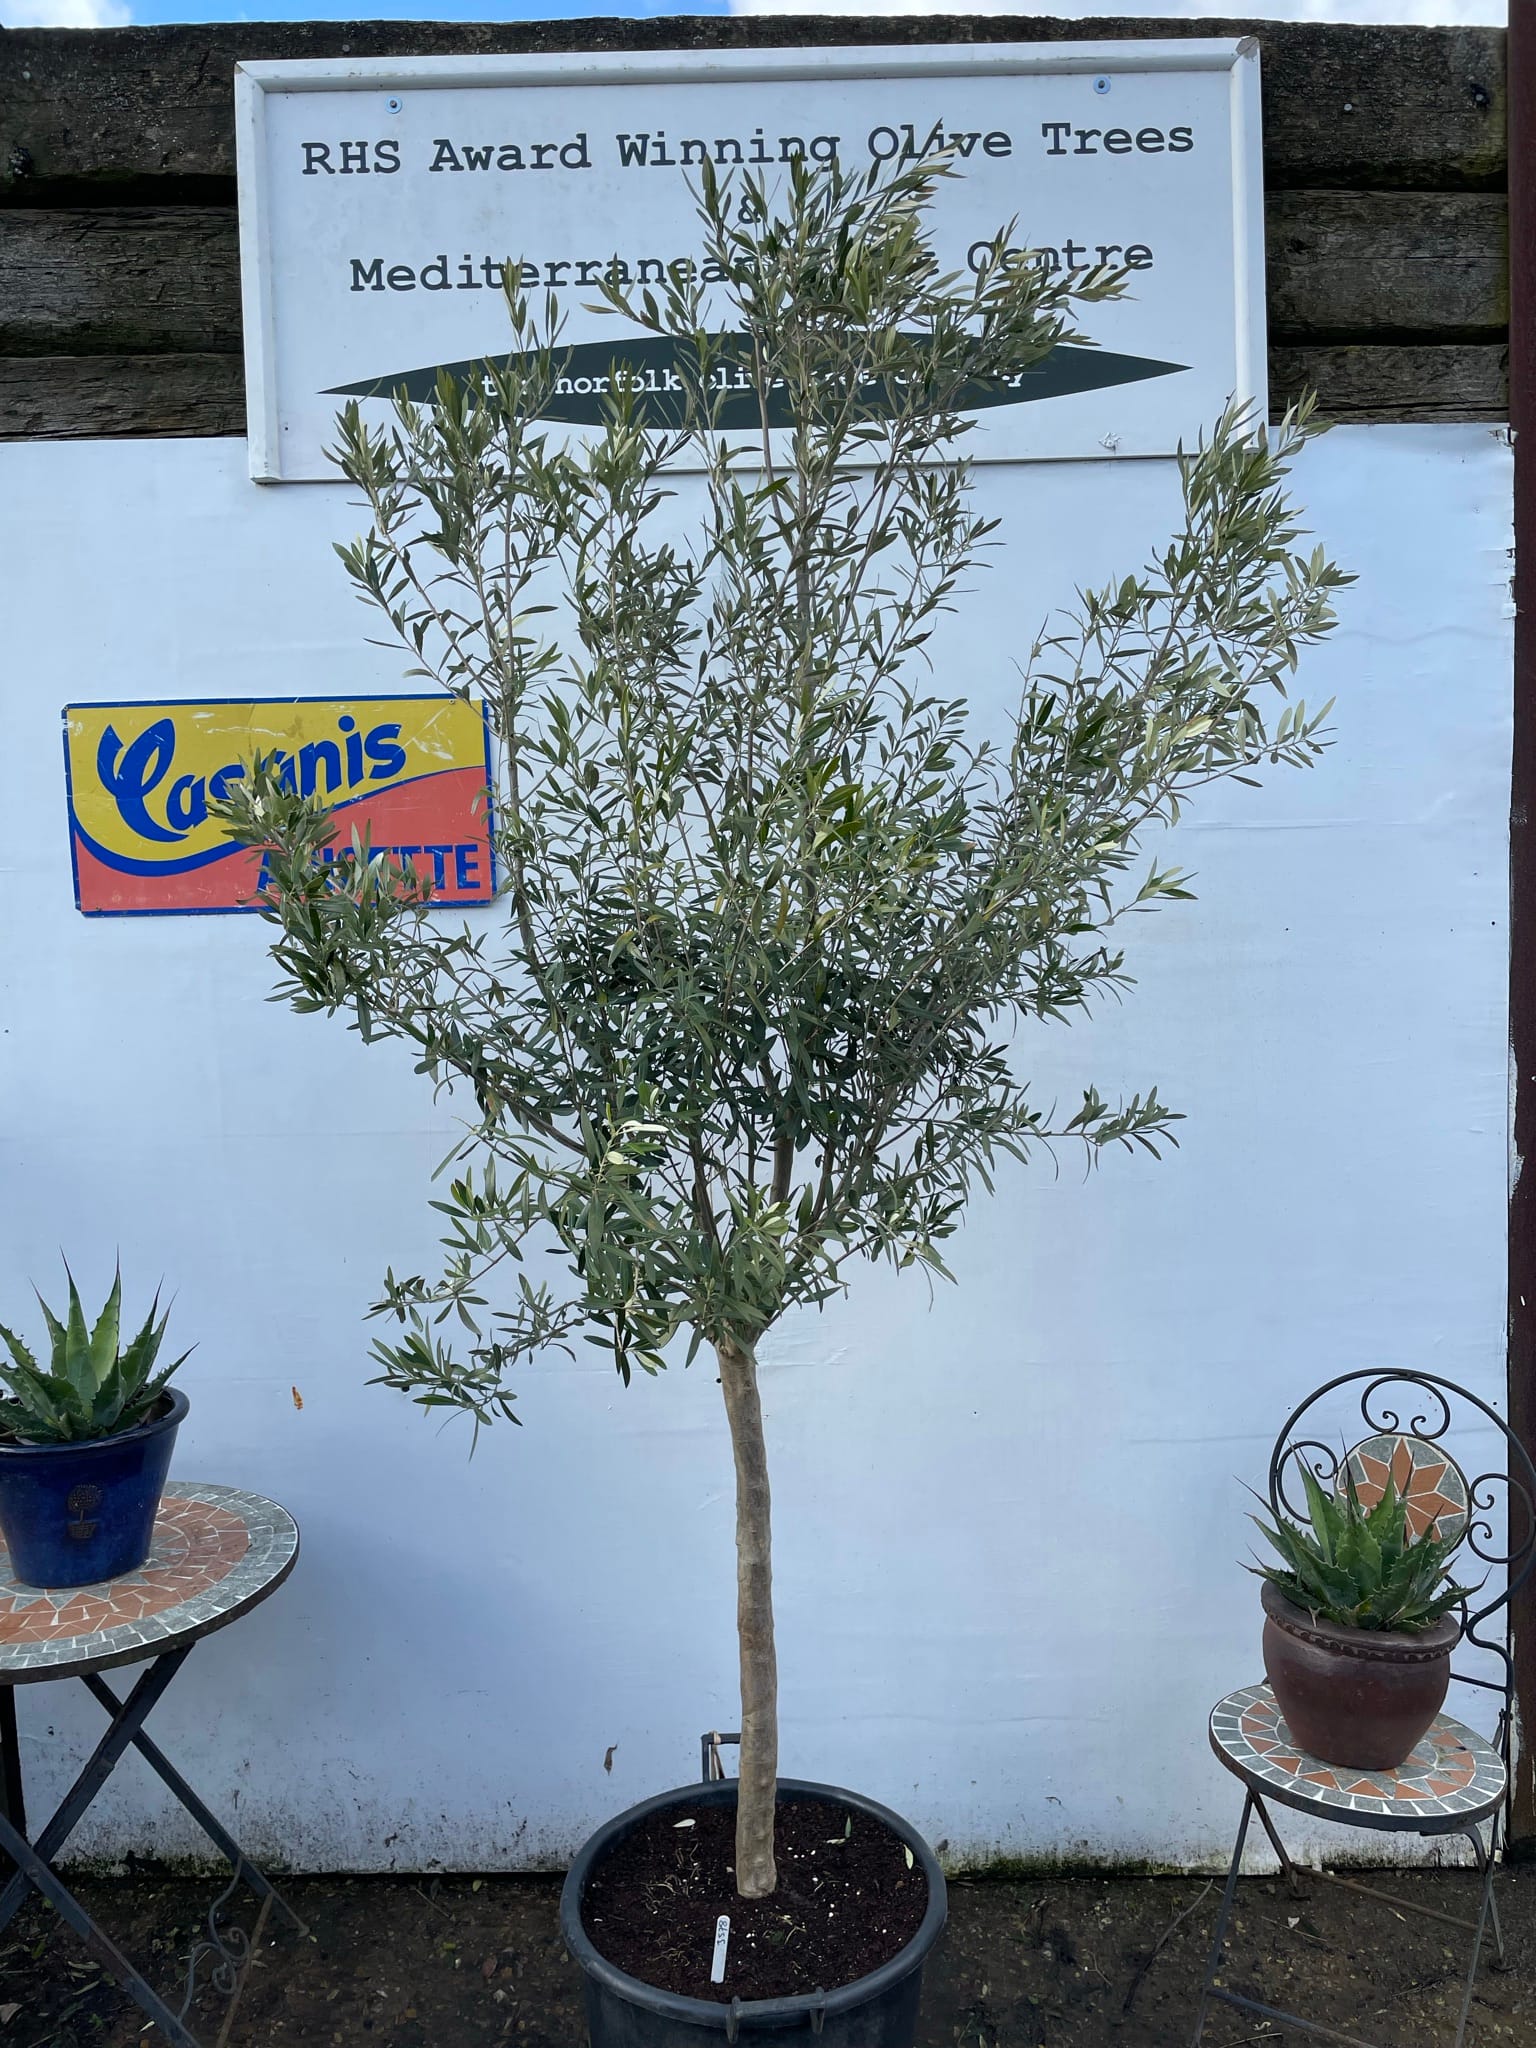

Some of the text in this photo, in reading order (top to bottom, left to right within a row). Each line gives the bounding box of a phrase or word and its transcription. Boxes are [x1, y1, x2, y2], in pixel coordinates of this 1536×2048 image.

[301, 122, 1194, 175] RHS Award Winning Olive Trees
[738, 194, 762, 224] &
[967, 238, 1153, 274] Centre
[554, 368, 682, 395] norfolk
[698, 366, 785, 390] oli
